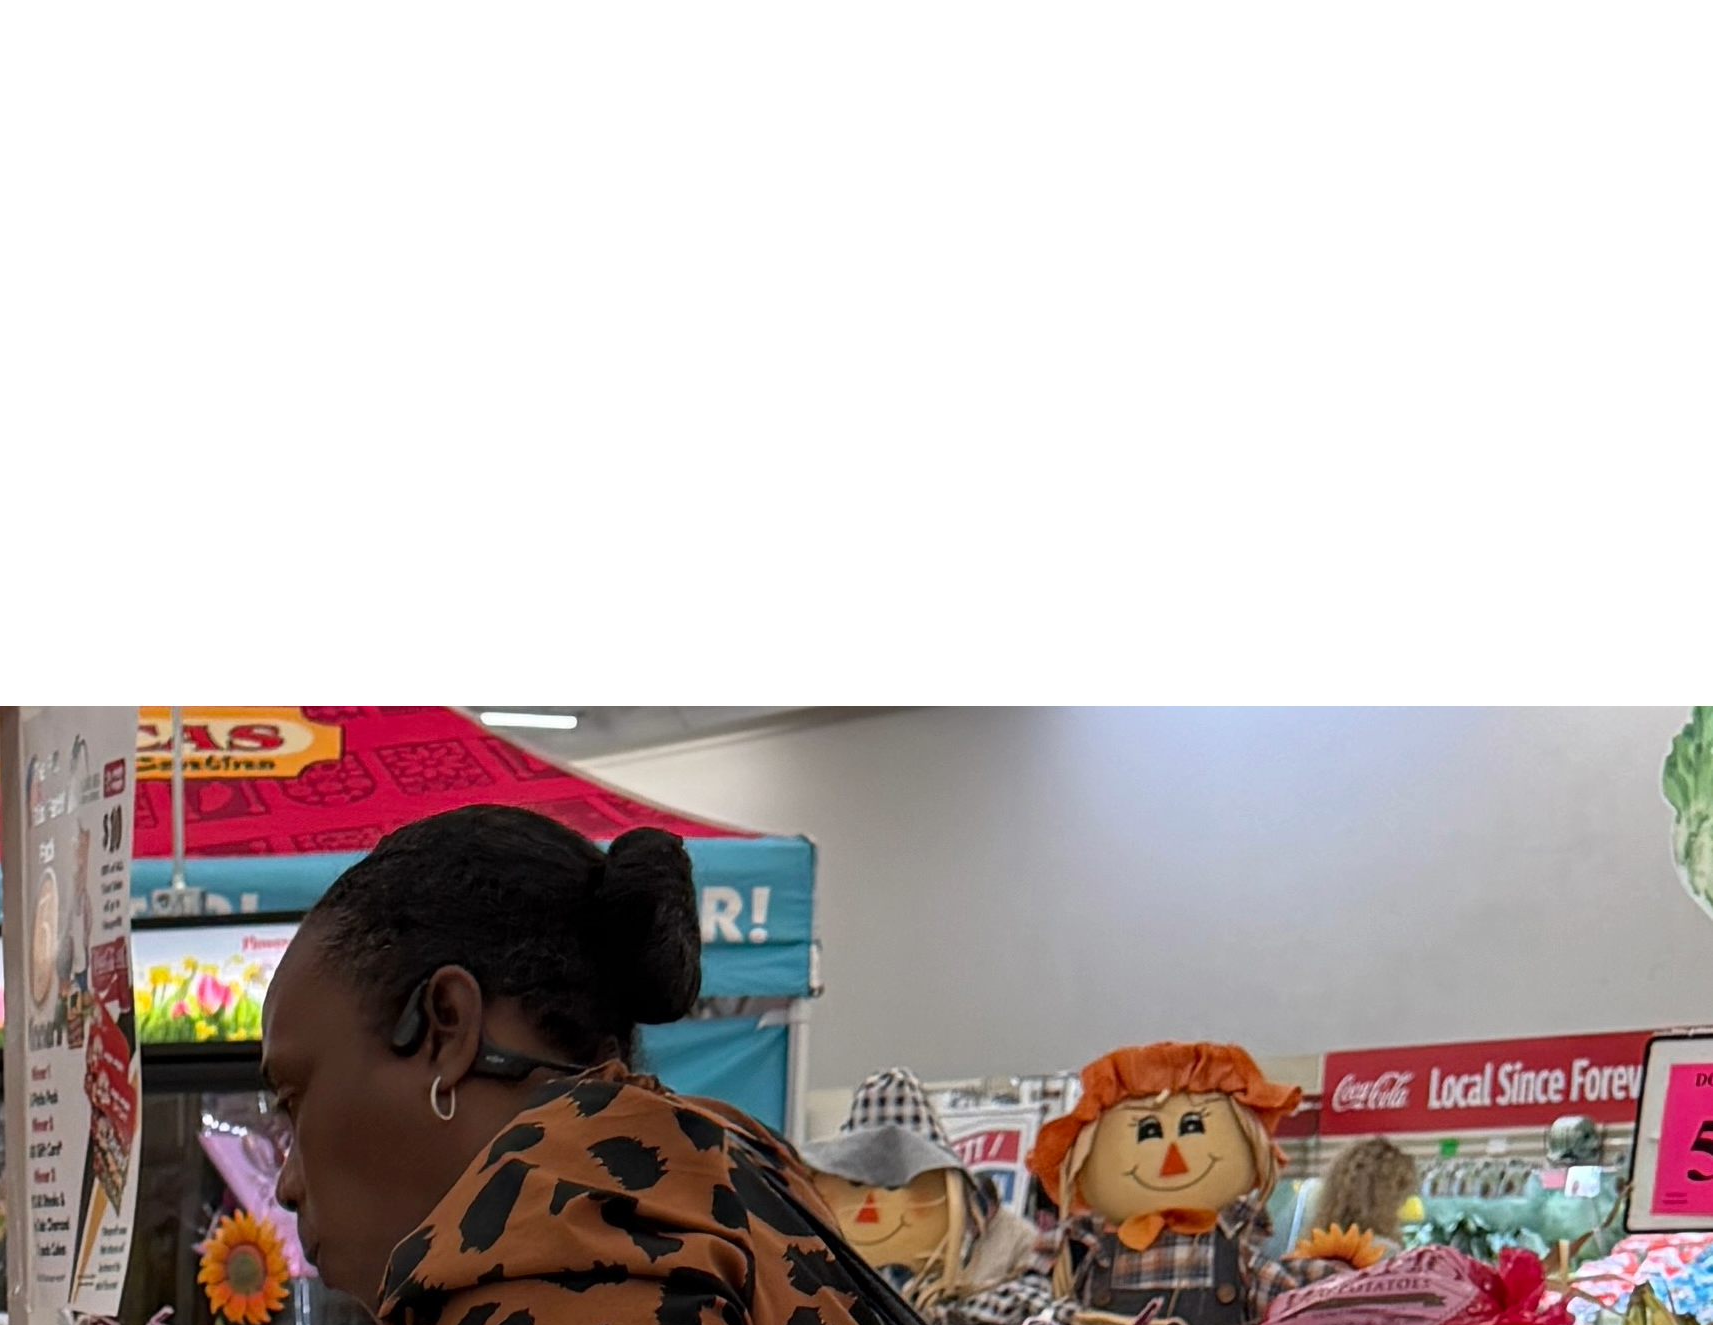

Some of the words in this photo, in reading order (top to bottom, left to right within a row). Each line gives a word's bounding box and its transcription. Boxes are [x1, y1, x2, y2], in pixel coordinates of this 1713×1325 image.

[1332, 1070, 1416, 1113] Coca-Cola
[1427, 1062, 1493, 1111] Local
[1495, 1061, 1564, 1107] Since
[1570, 1057, 1643, 1101] Forev
